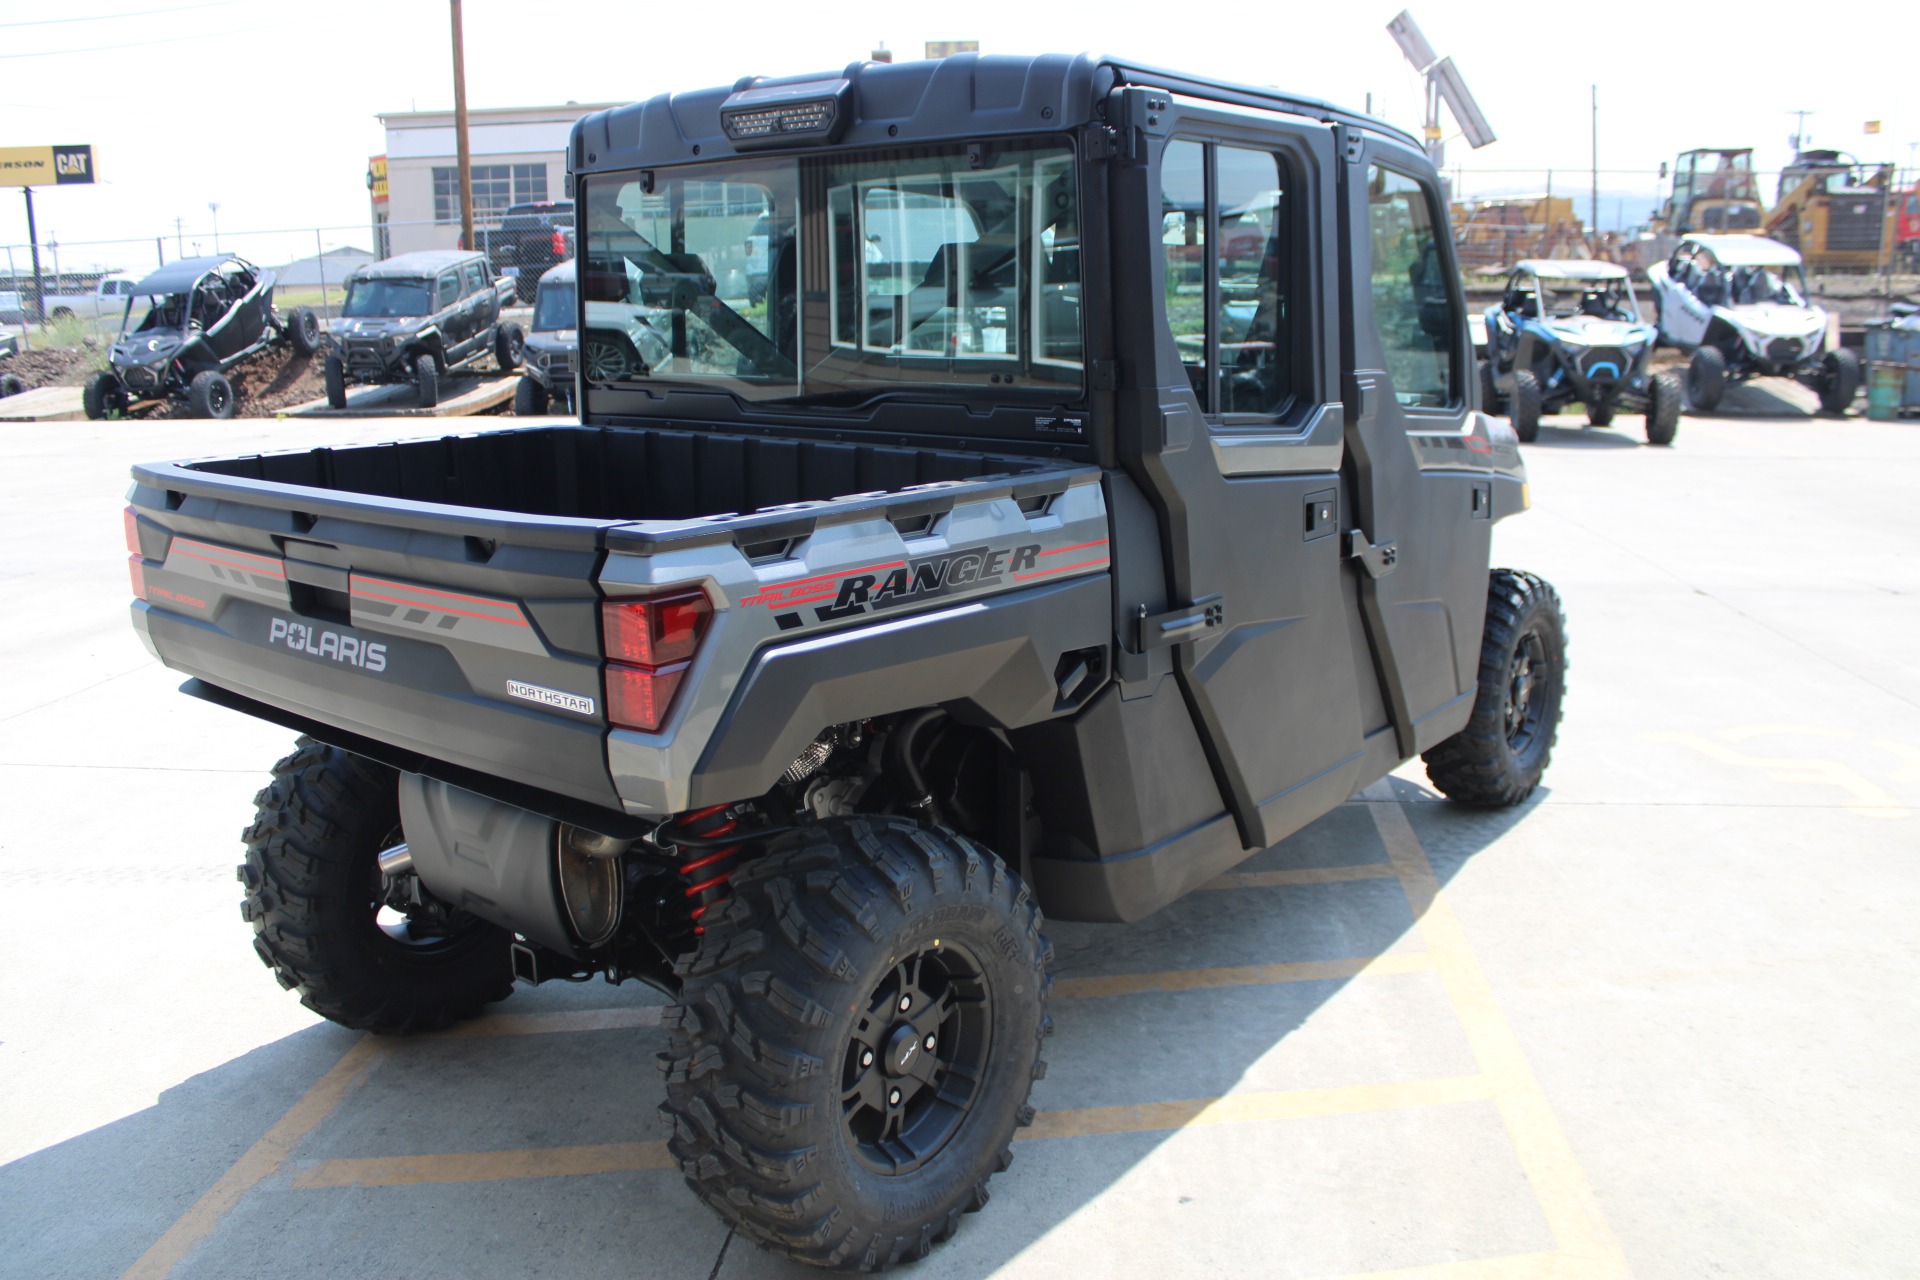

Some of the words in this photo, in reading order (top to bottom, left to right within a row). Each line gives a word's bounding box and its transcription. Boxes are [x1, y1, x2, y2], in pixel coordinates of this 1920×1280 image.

[56, 153, 87, 175] CAT
[831, 544, 1042, 611] RANGER
[740, 590, 787, 608] TRAIL
[788, 581, 836, 599] BOSS
[269, 617, 387, 672] POLARIS
[510, 683, 588, 711] NORTHSTAR
